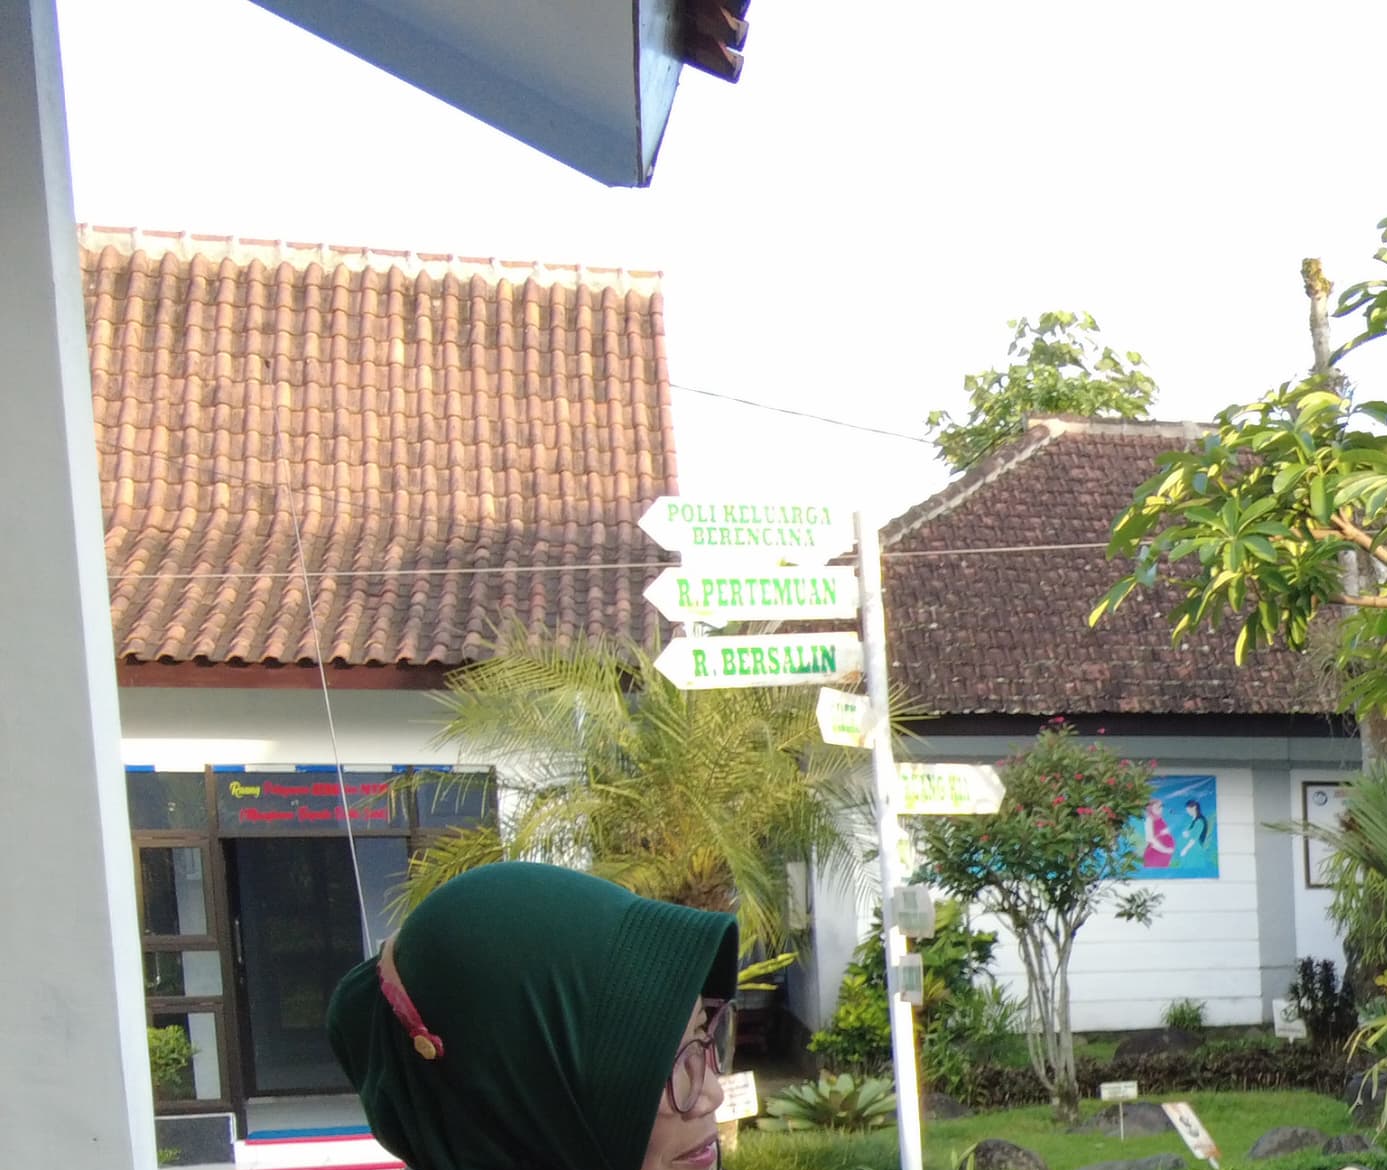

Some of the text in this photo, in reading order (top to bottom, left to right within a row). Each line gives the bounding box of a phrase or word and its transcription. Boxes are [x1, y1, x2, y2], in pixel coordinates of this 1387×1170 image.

[667, 503, 833, 526] POLI KELUARGA
[692, 526, 816, 547] BERENCANA
[721, 644, 837, 676] BERSALIN
